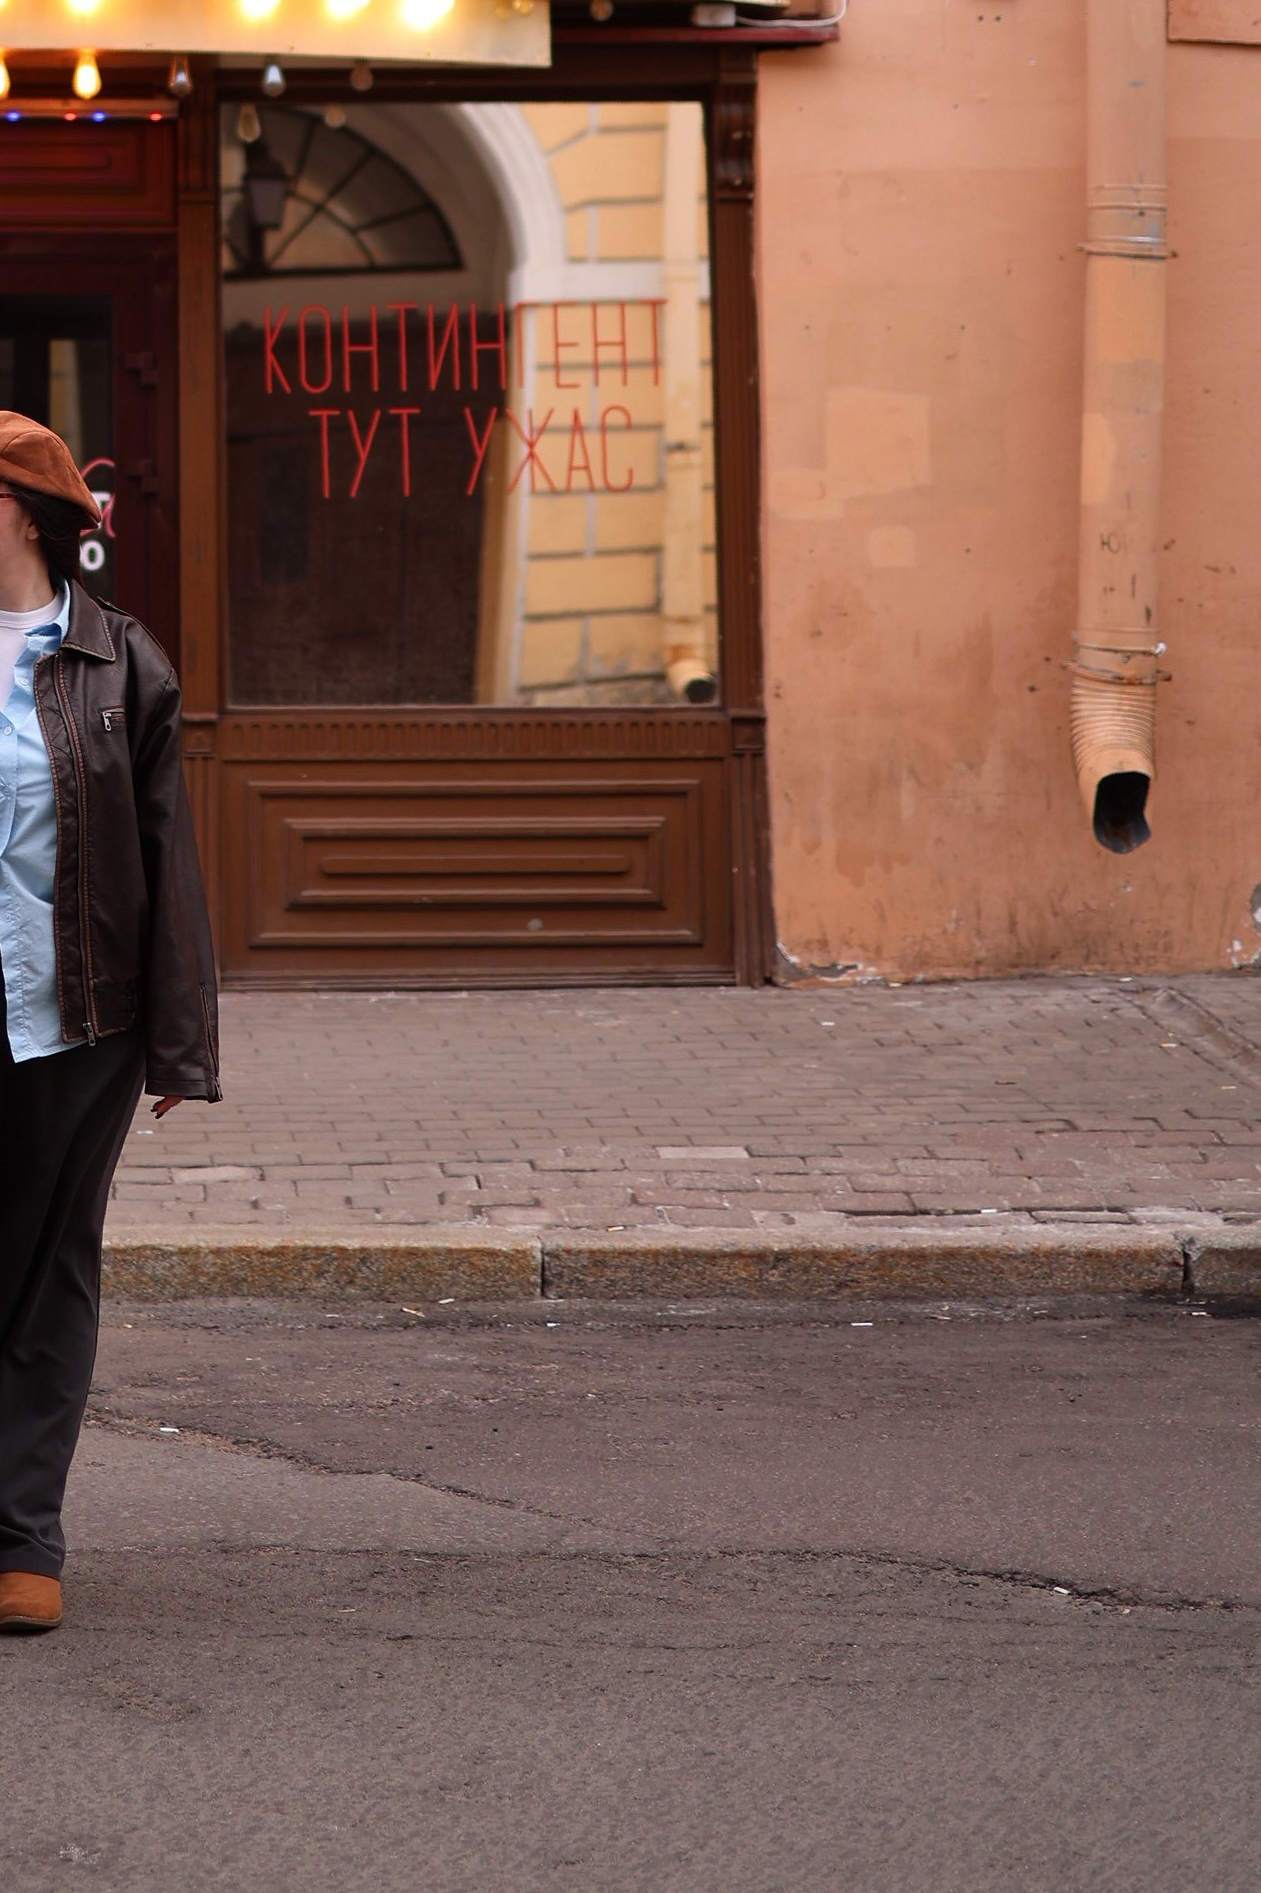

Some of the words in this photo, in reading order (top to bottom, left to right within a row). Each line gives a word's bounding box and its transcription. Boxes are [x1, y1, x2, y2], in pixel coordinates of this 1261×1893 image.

[263, 298, 668, 395] КОНТИНГЕНТ
[308, 407, 422, 498] ТУТ
[464, 404, 635, 497] УЖАС
